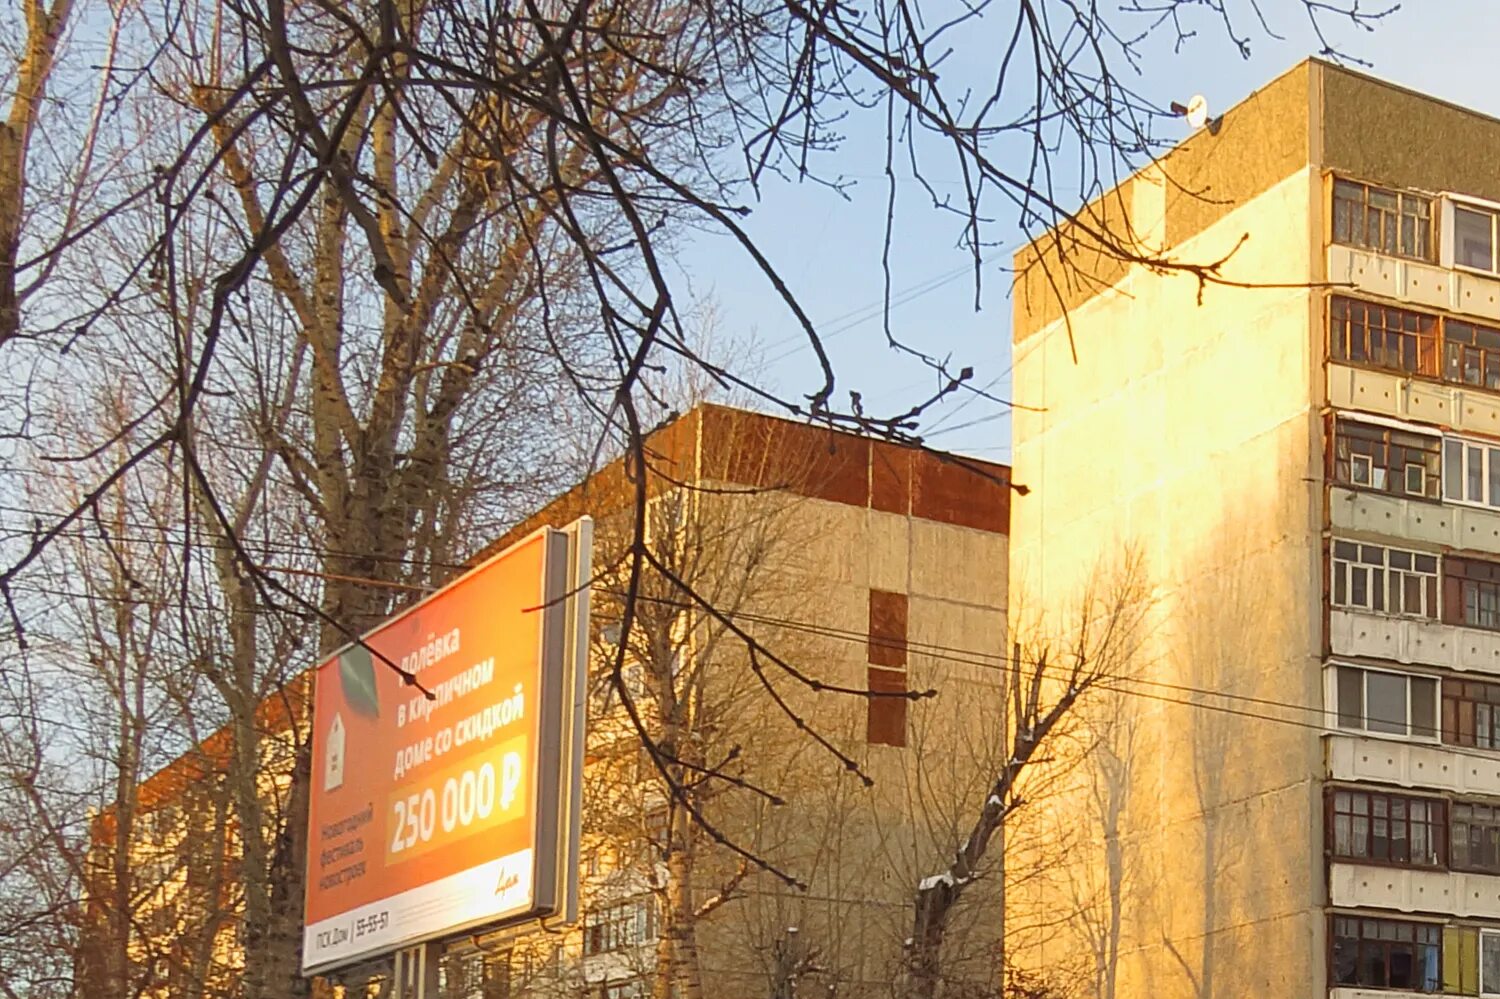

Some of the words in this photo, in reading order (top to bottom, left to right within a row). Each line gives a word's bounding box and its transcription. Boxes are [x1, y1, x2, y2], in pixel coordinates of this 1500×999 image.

[394, 736, 433, 781] доме
[434, 727, 452, 756] со
[454, 682, 524, 747] скидкой
[397, 703, 406, 728] в
[408, 656, 495, 723] кирпичном
[391, 787, 436, 854] 250
[441, 761, 495, 833] 000
